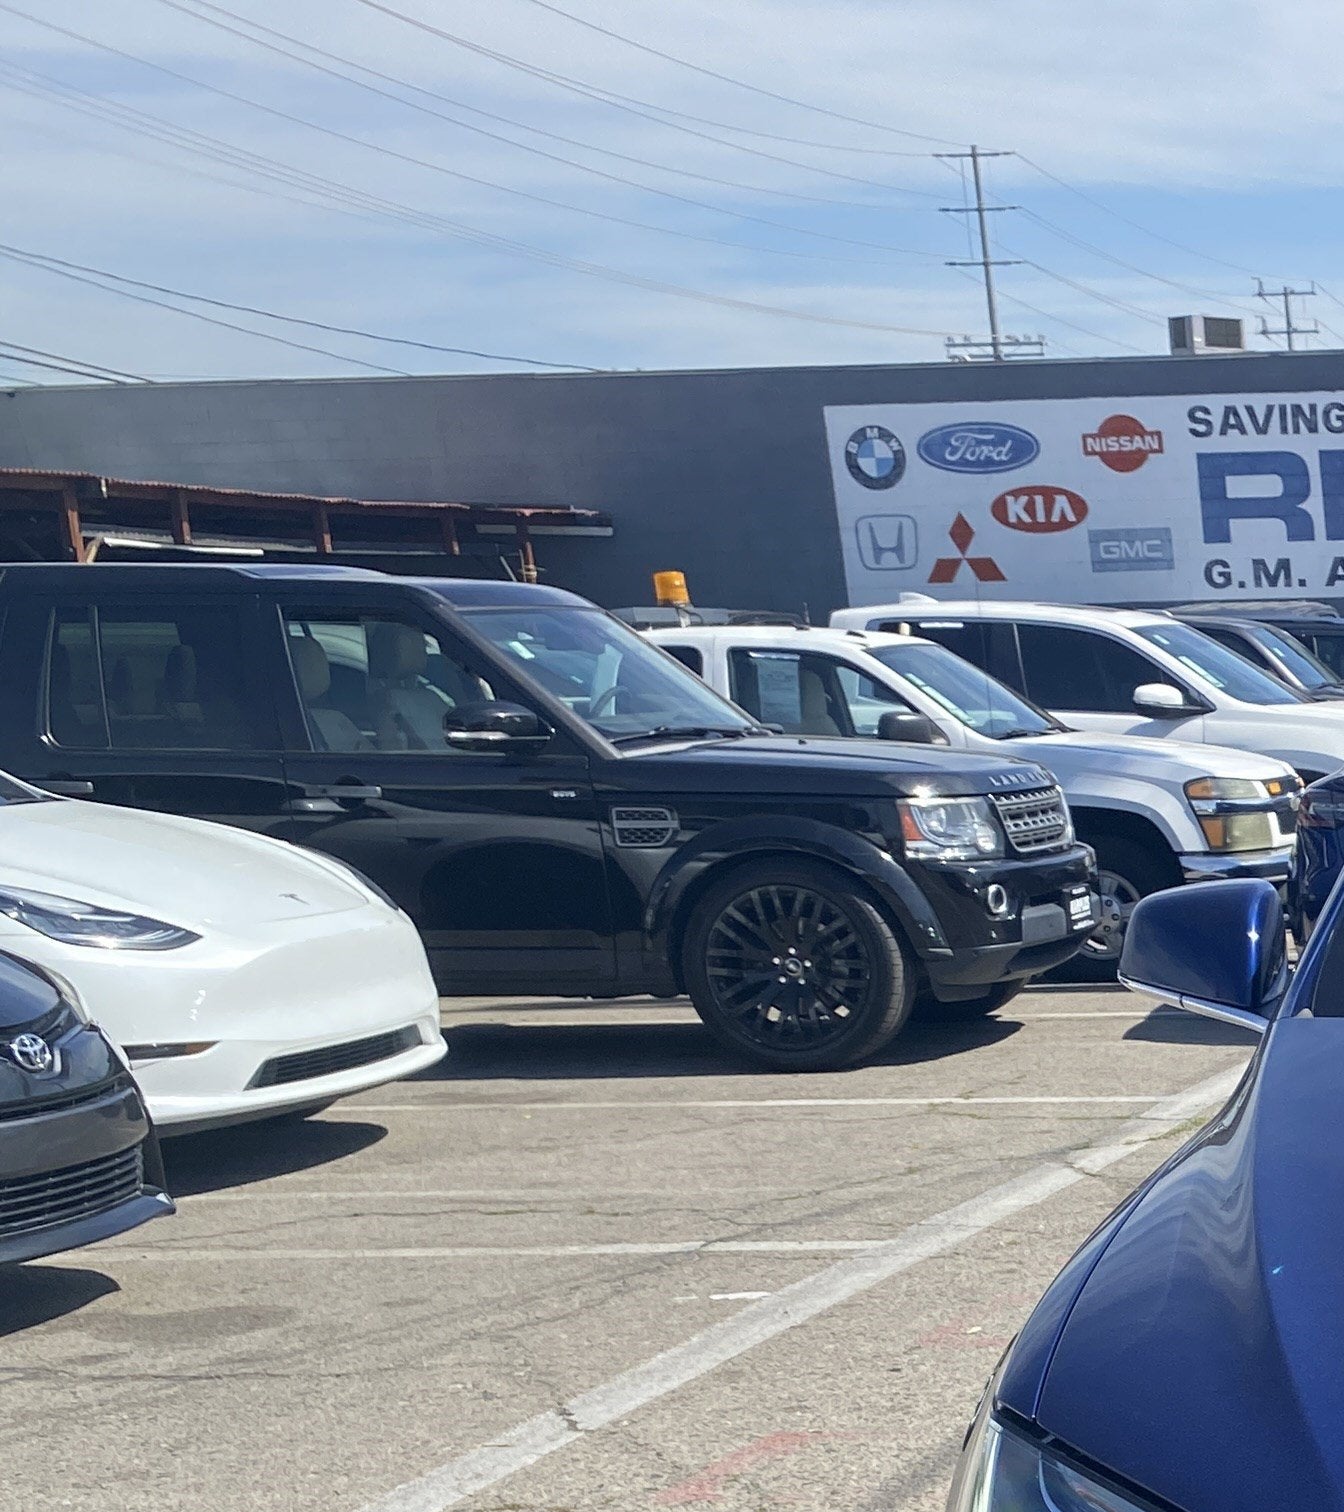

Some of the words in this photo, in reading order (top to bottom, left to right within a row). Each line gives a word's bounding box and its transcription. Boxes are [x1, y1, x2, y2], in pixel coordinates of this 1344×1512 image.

[945, 432, 1013, 462] Ford
[1085, 434, 1159, 452] NISSAN
[1004, 494, 1077, 524] KIA
[1100, 539, 1164, 558] GMC
[1203, 557, 1307, 590] G.M.
